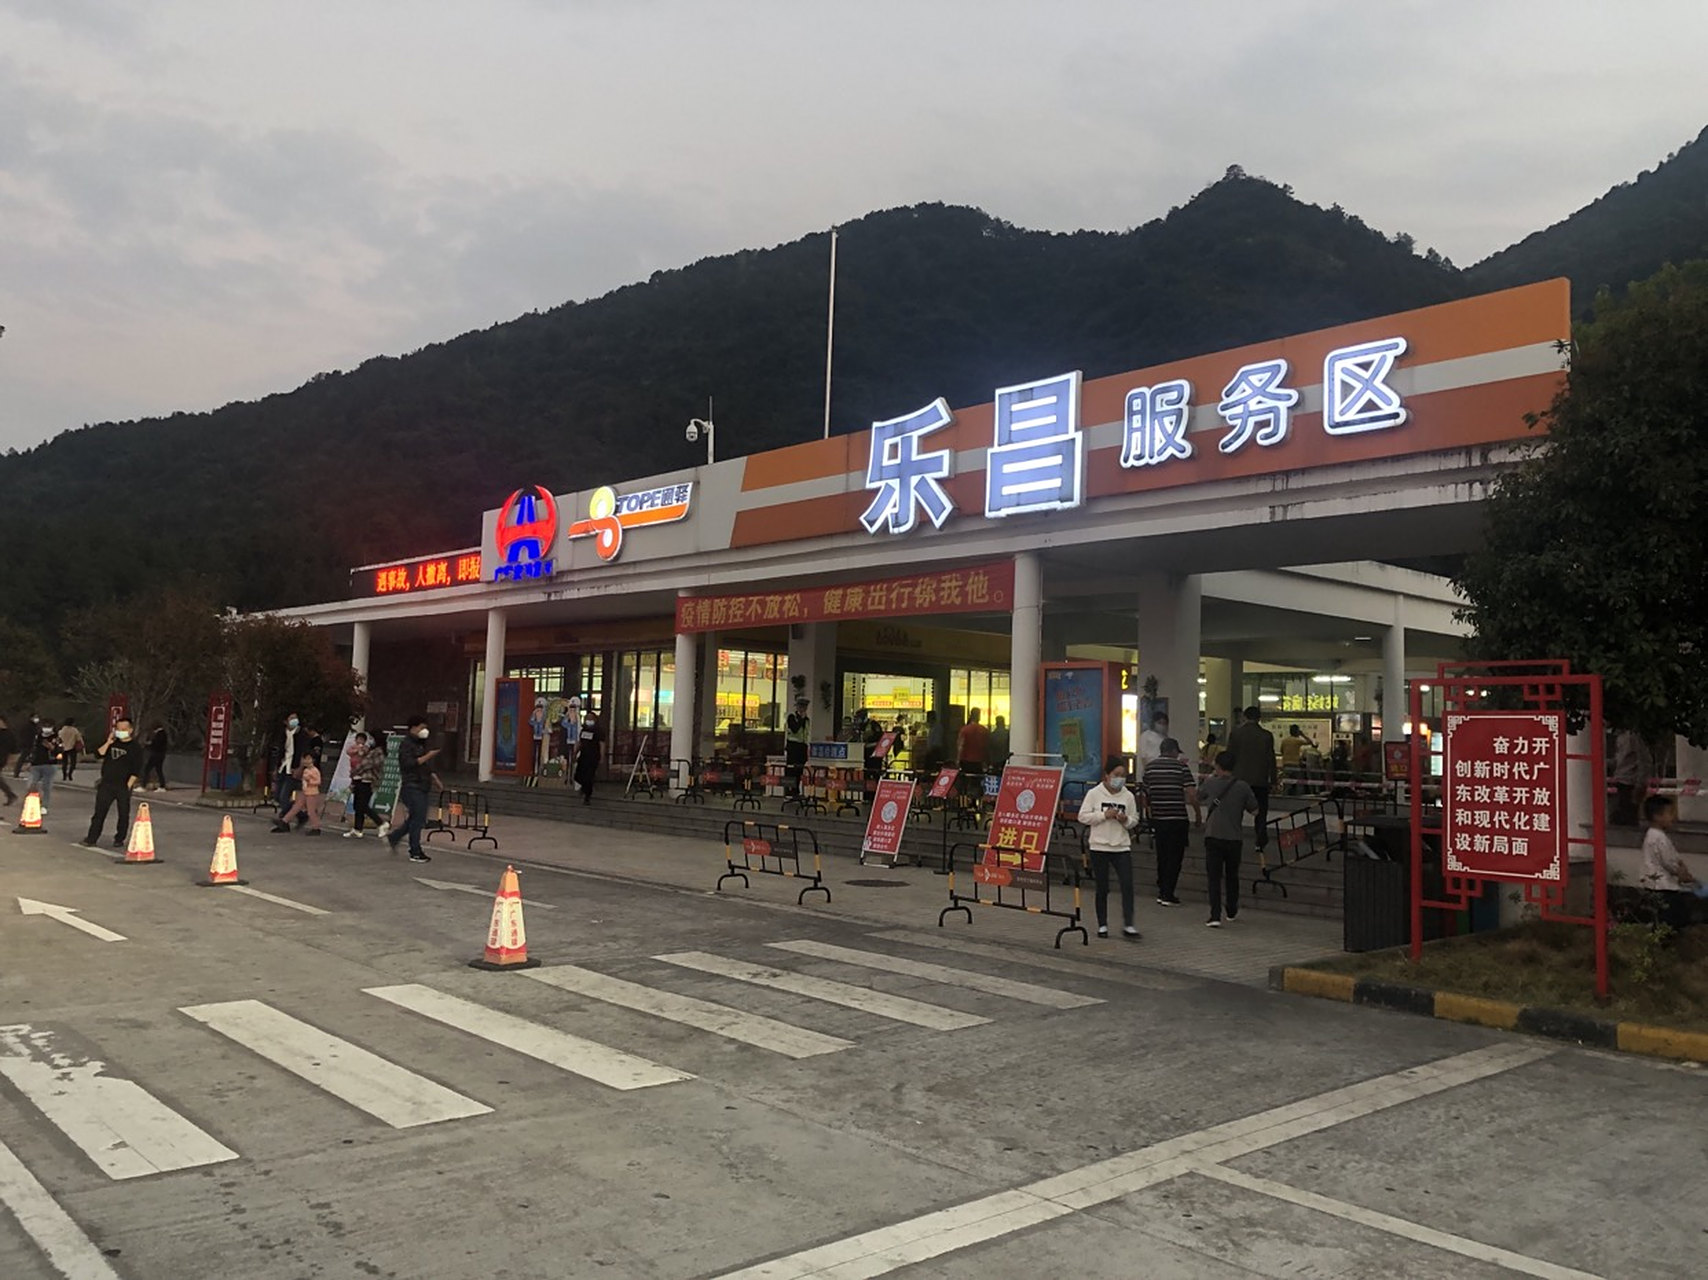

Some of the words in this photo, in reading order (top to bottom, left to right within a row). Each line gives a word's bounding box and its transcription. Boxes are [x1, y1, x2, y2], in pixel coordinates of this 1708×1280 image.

[860, 337, 1409, 535] 乐昌服务区
[1493, 736, 1550, 755] 奋力开
[1455, 760, 1550, 781] 创新时代广
[1455, 784, 1551, 807] 东改革开放
[1455, 808, 1551, 832] 和现代化建
[997, 827, 1038, 851] 进口
[1455, 832, 1529, 856] 设新局面
